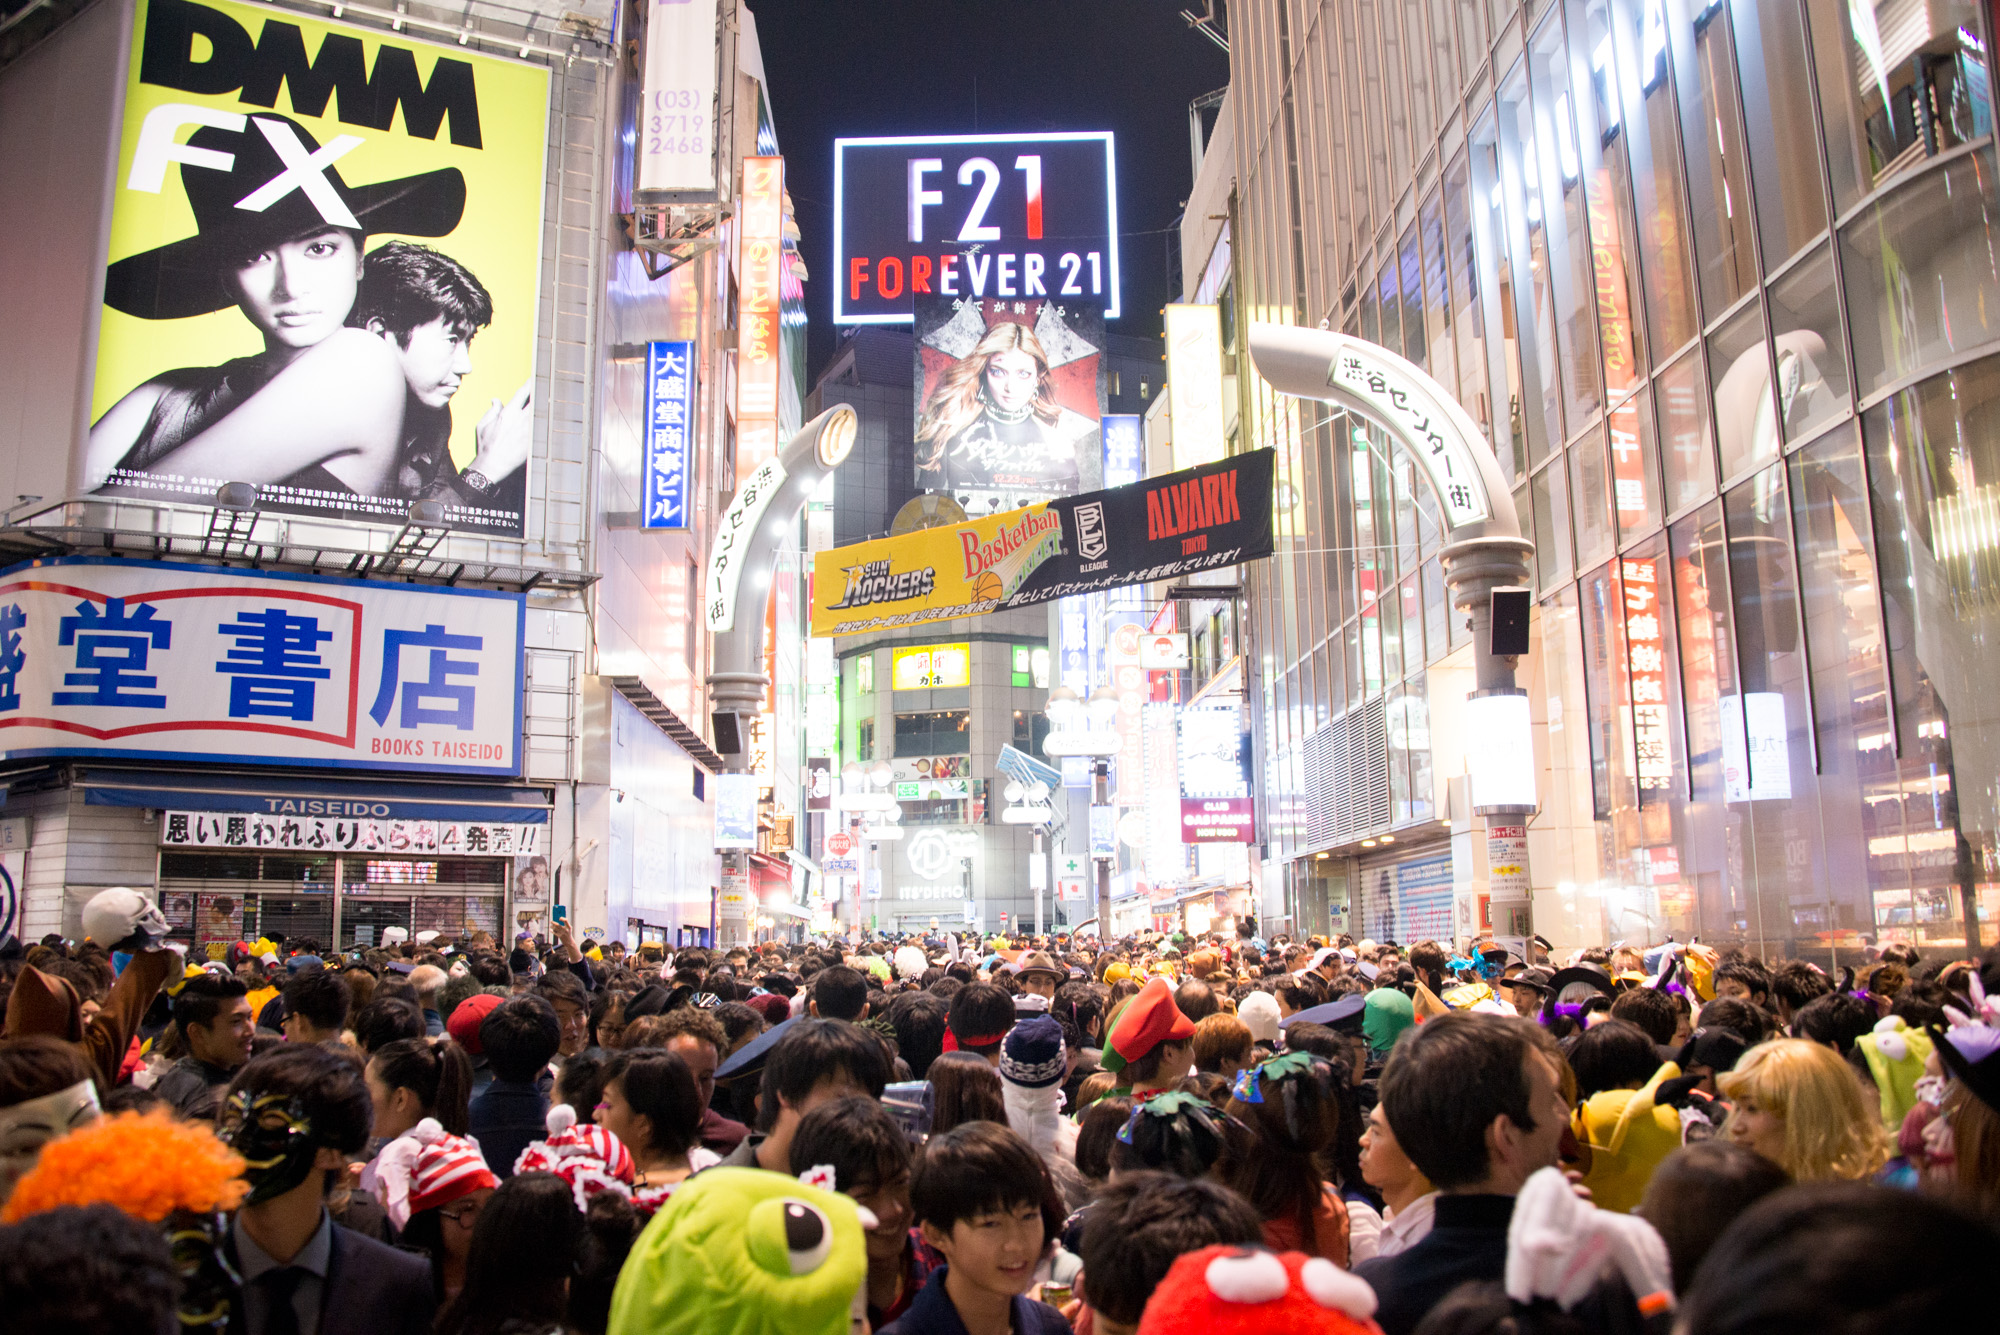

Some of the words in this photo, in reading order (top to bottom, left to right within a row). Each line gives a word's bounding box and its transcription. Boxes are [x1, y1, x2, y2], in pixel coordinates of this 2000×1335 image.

[139, 0, 484, 150] DMM
[655, 89, 701, 111] (03)
[650, 115, 704, 134] 3719
[649, 136, 704, 155] 2468
[127, 103, 366, 230] FX
[907, 155, 1043, 242] F21
[850, 252, 1047, 300] FOREVER
[1059, 251, 1101, 294] 21
[653, 351, 686, 521] 大盛堂商事ビル
[1343, 357, 1472, 510] 渋谷センター街
[1146, 469, 1241, 541] ALVARK
[709, 466, 773, 624] 渋谷センター街
[959, 511, 1060, 580] Basketball
[1181, 533, 1208, 556] TOKYO
[864, 559, 891, 578] SUN
[1080, 560, 1109, 573] B.LEAGUE
[826, 564, 936, 610] ROCKERS
[919, 675, 944, 686] カホ
[371, 737, 425, 756] BOOKS
[432, 741, 504, 761] TAISEIDO
[264, 798, 391, 818] TAISEIDO
[829, 839, 850, 850] 消火栓
